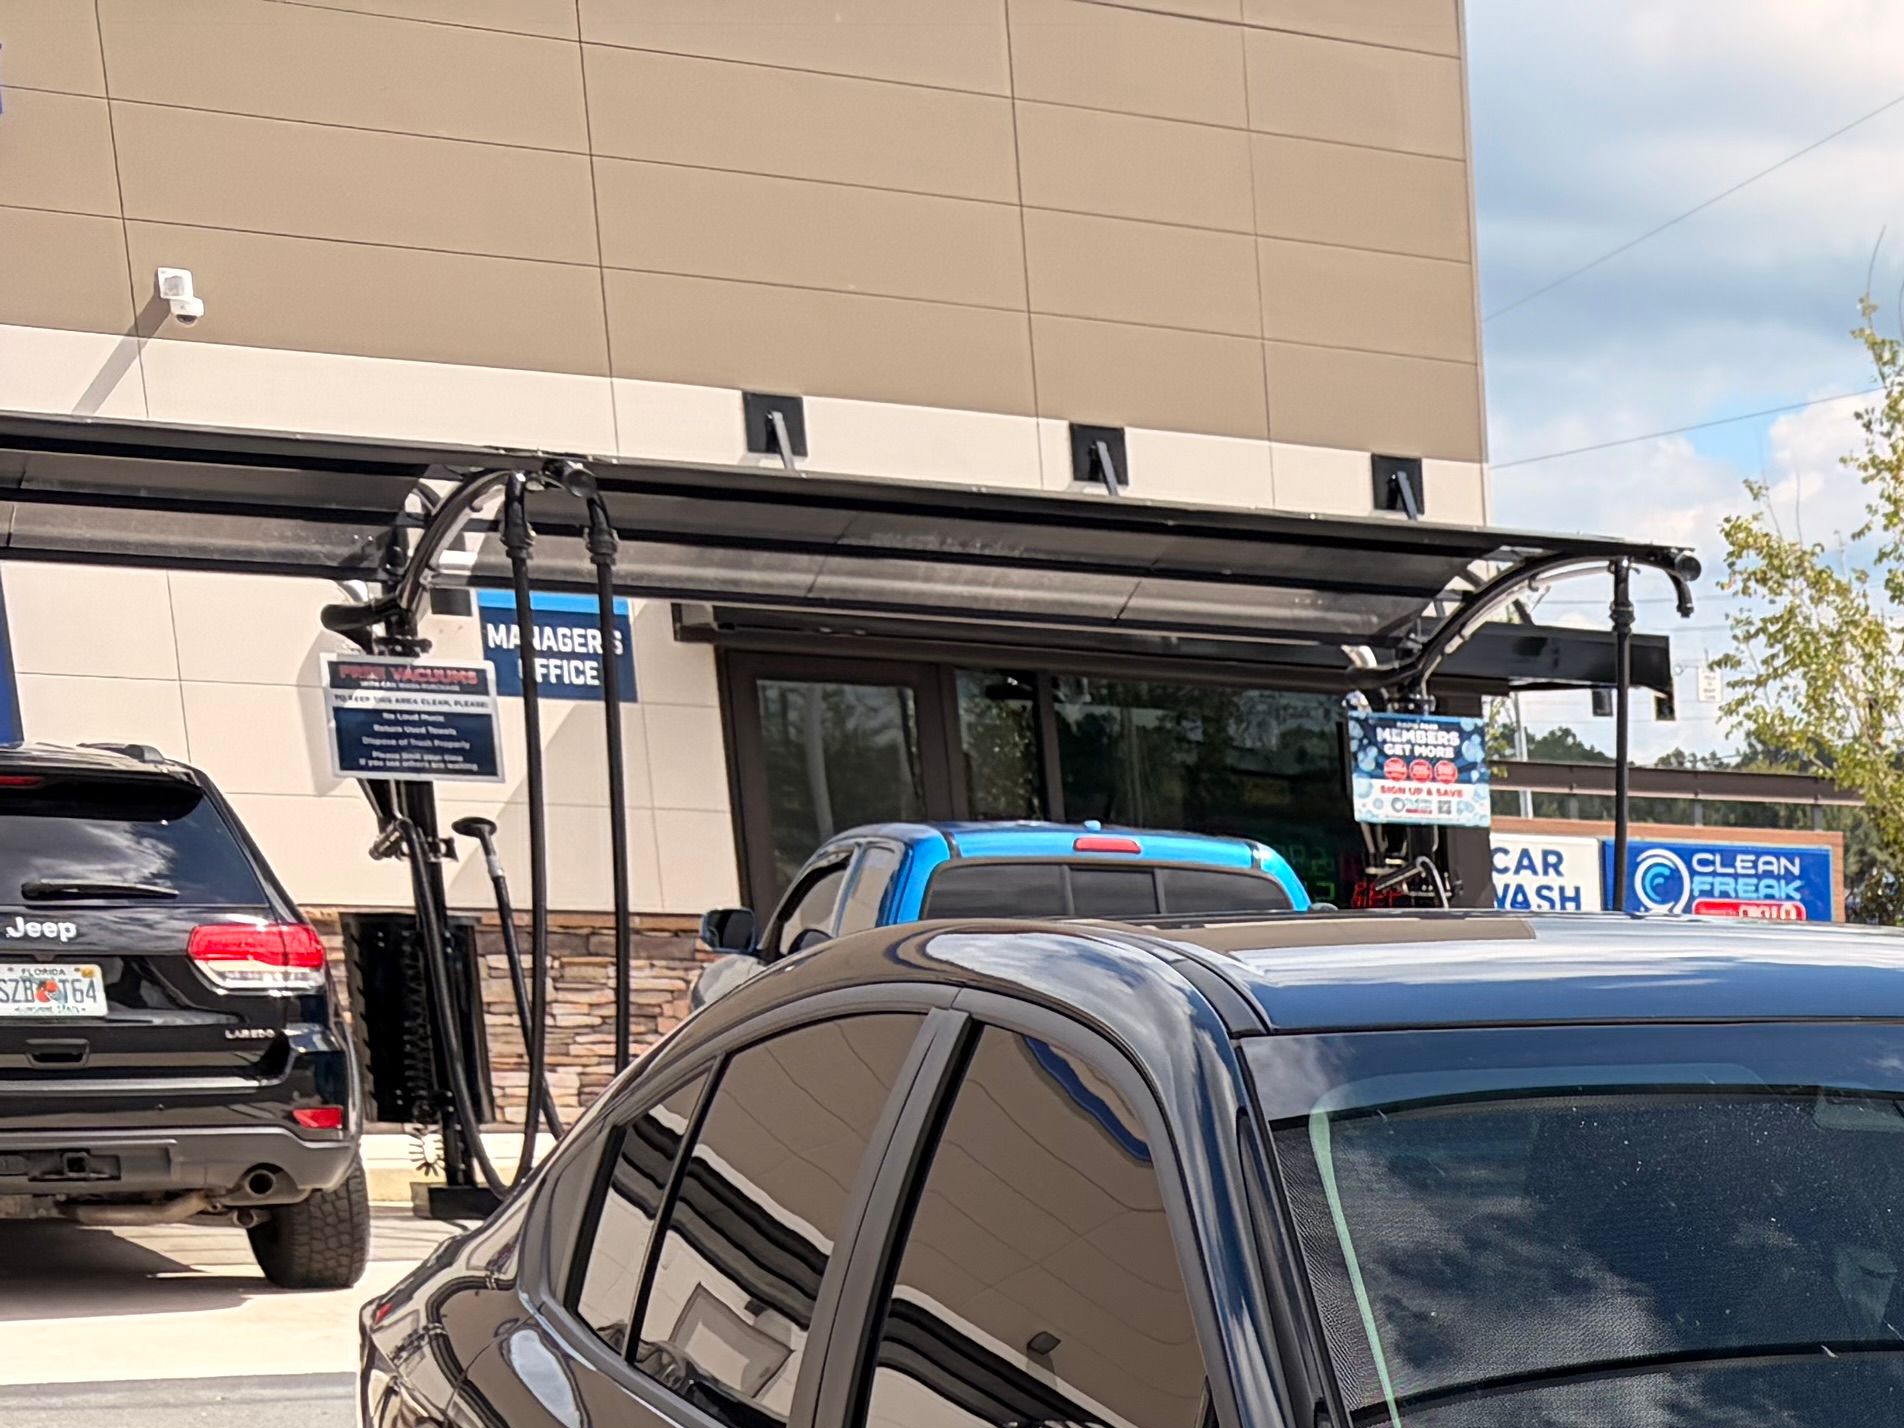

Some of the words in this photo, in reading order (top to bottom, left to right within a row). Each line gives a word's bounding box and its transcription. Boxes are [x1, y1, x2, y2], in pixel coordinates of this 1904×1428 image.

[389, 666, 479, 685] VACUUMS
[518, 657, 600, 686] FFICE
[1376, 727, 1460, 746] MEMBERS
[1383, 743, 1412, 756] GET
[1413, 744, 1455, 758] MORE
[1381, 785, 1406, 795] SIGN
[1408, 787, 1424, 796] UP
[1436, 789, 1464, 798] SAVE
[1491, 846, 1565, 878] CAR
[1691, 852, 1800, 877] CLEAN
[1692, 875, 1805, 900] FREAK
[6, 916, 78, 942] Jeep
